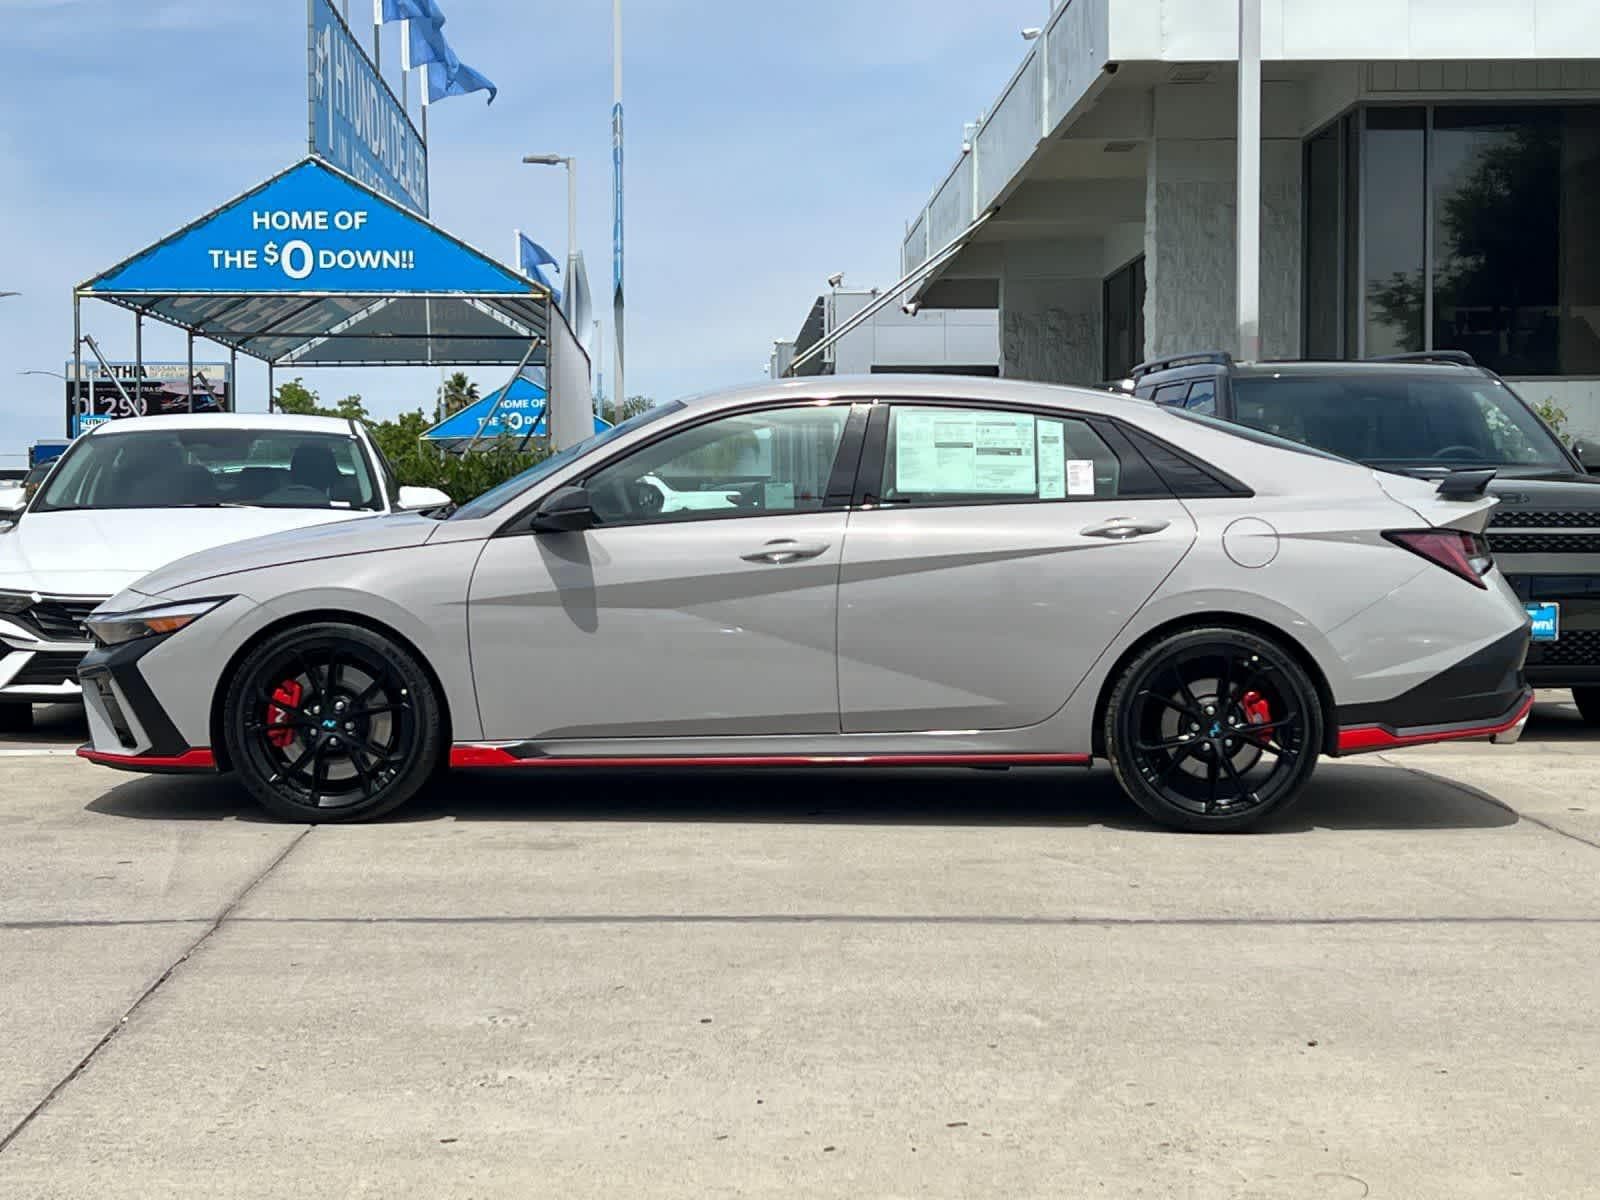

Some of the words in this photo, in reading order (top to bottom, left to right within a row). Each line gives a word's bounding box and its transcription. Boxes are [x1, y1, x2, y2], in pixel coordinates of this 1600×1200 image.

[334, 27, 390, 173] HYUNDAI
[253, 211, 328, 230] HOME
[334, 211, 368, 230] OF
[208, 250, 258, 269] THE
[263, 239, 314, 279] $0
[319, 250, 414, 269] DOWN!!
[100, 365, 148, 378] LTHIA
